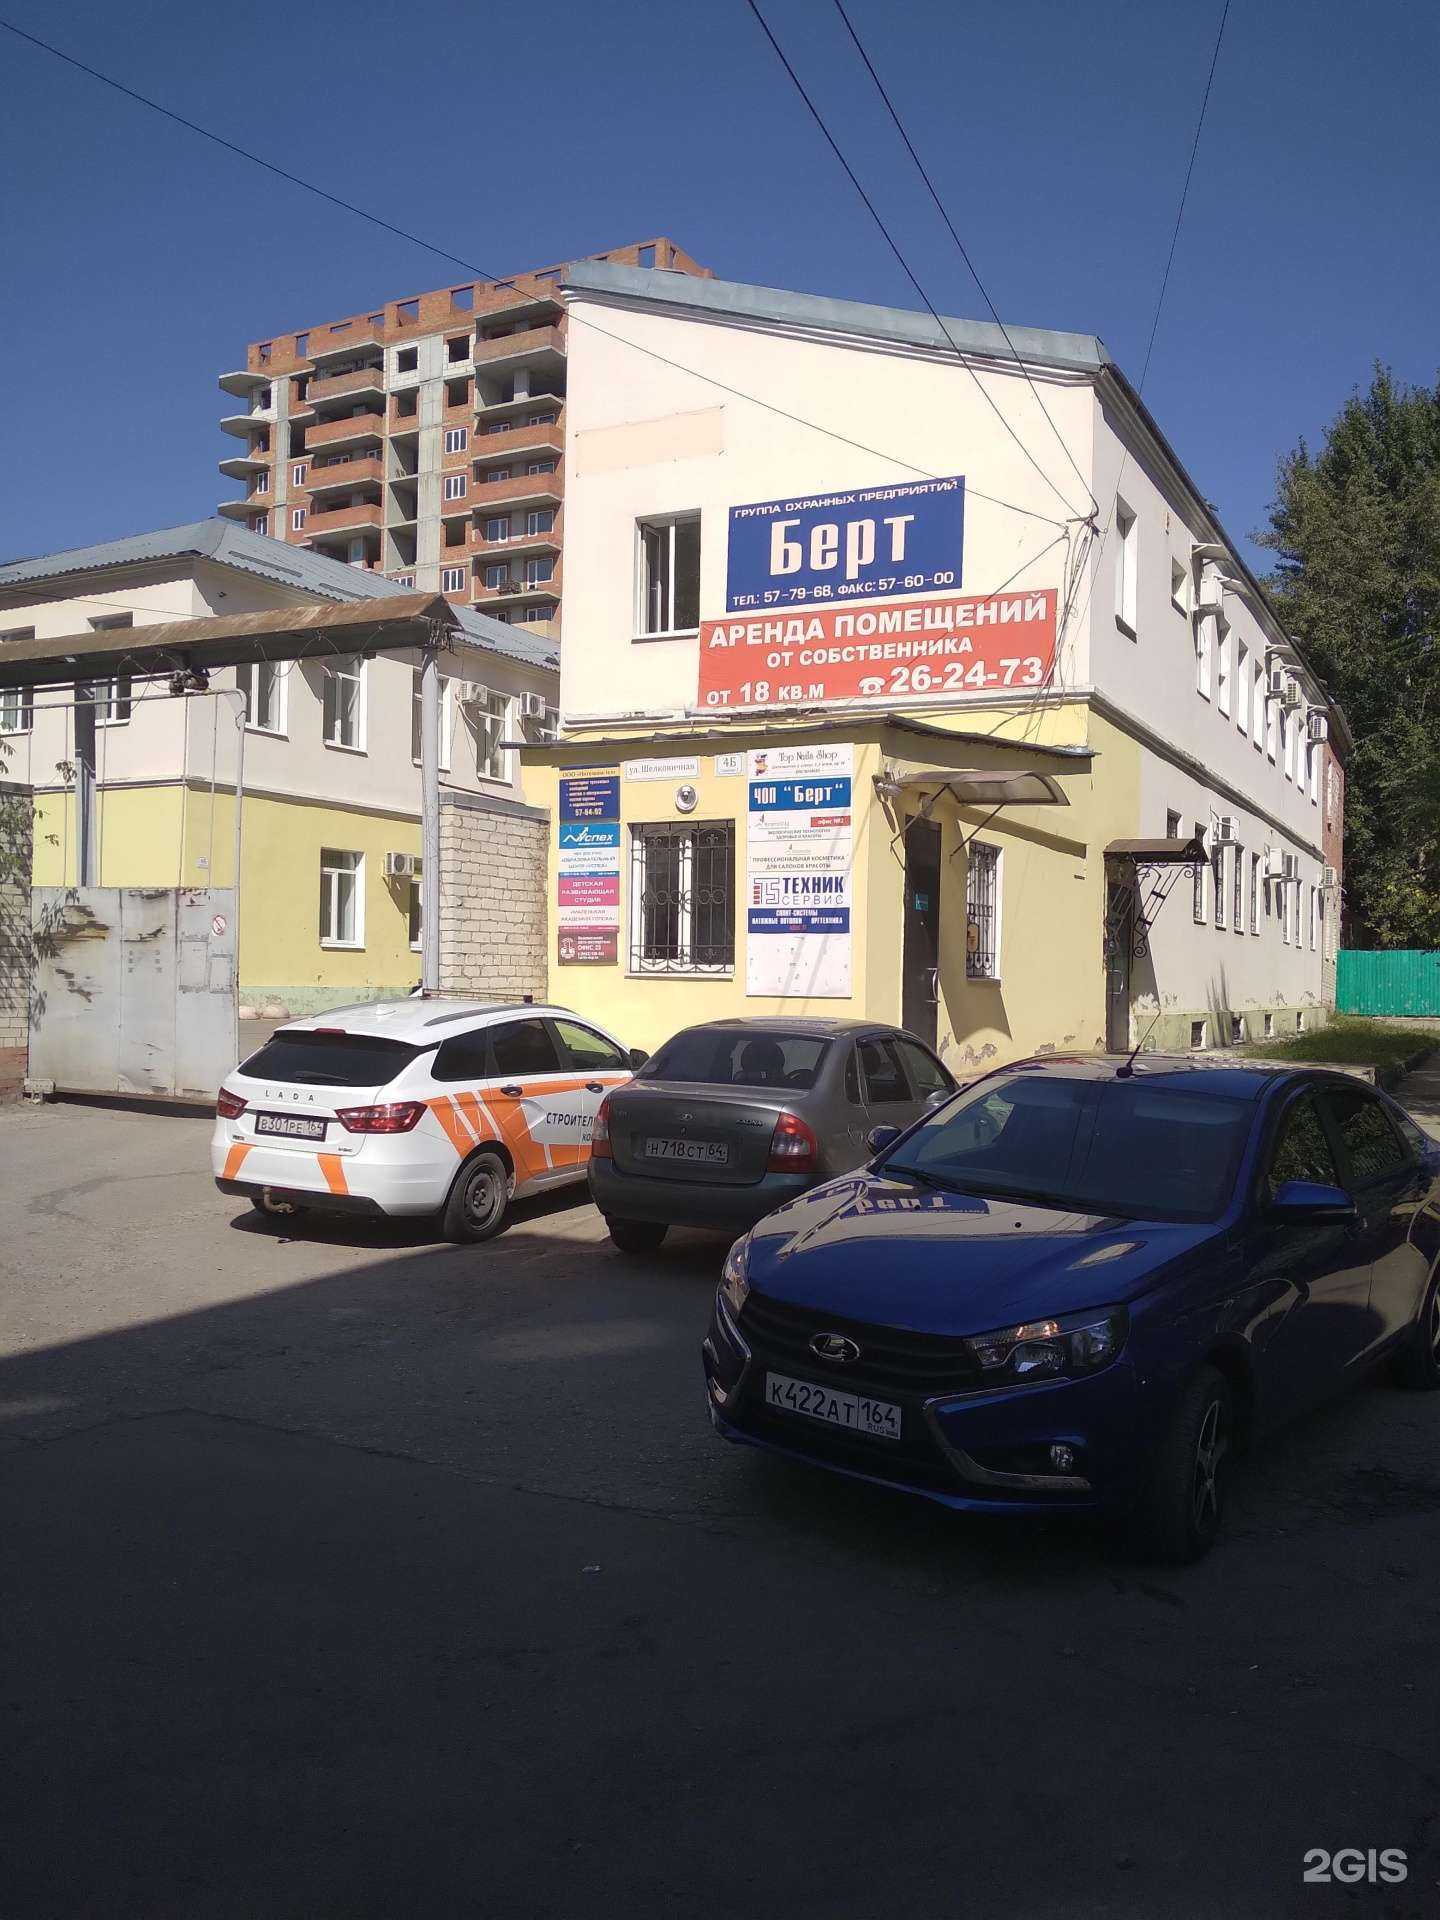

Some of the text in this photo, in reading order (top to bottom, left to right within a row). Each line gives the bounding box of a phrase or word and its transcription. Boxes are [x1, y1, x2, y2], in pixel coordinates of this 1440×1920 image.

[735, 478, 957, 518] ГРУППА ОХРАННЫХ ПРЕДПРИЯТИЙ
[770, 515, 914, 580] Берт
[838, 581, 876, 594] ФАКС:
[879, 572, 954, 590] 57-60-00
[709, 591, 1046, 648] АРЕНДА ПОМЕЩЕНИЙ
[767, 629, 974, 668] ОТ СОБСТВЕННИКА
[890, 657, 1043, 693] 26-24-73
[740, 681, 770, 703] 18
[723, 757, 737, 767] 4Б
[779, 752, 794, 763] Top
[816, 750, 837, 761] Shop
[782, 876, 844, 894] ТЕХНИК
[782, 894, 844, 905] СЕРВИС
[265, 1090, 314, 1101] LADA
[547, 1112, 595, 1126] СТРОИТЕЛ
[862, 1401, 896, 1428] 164
